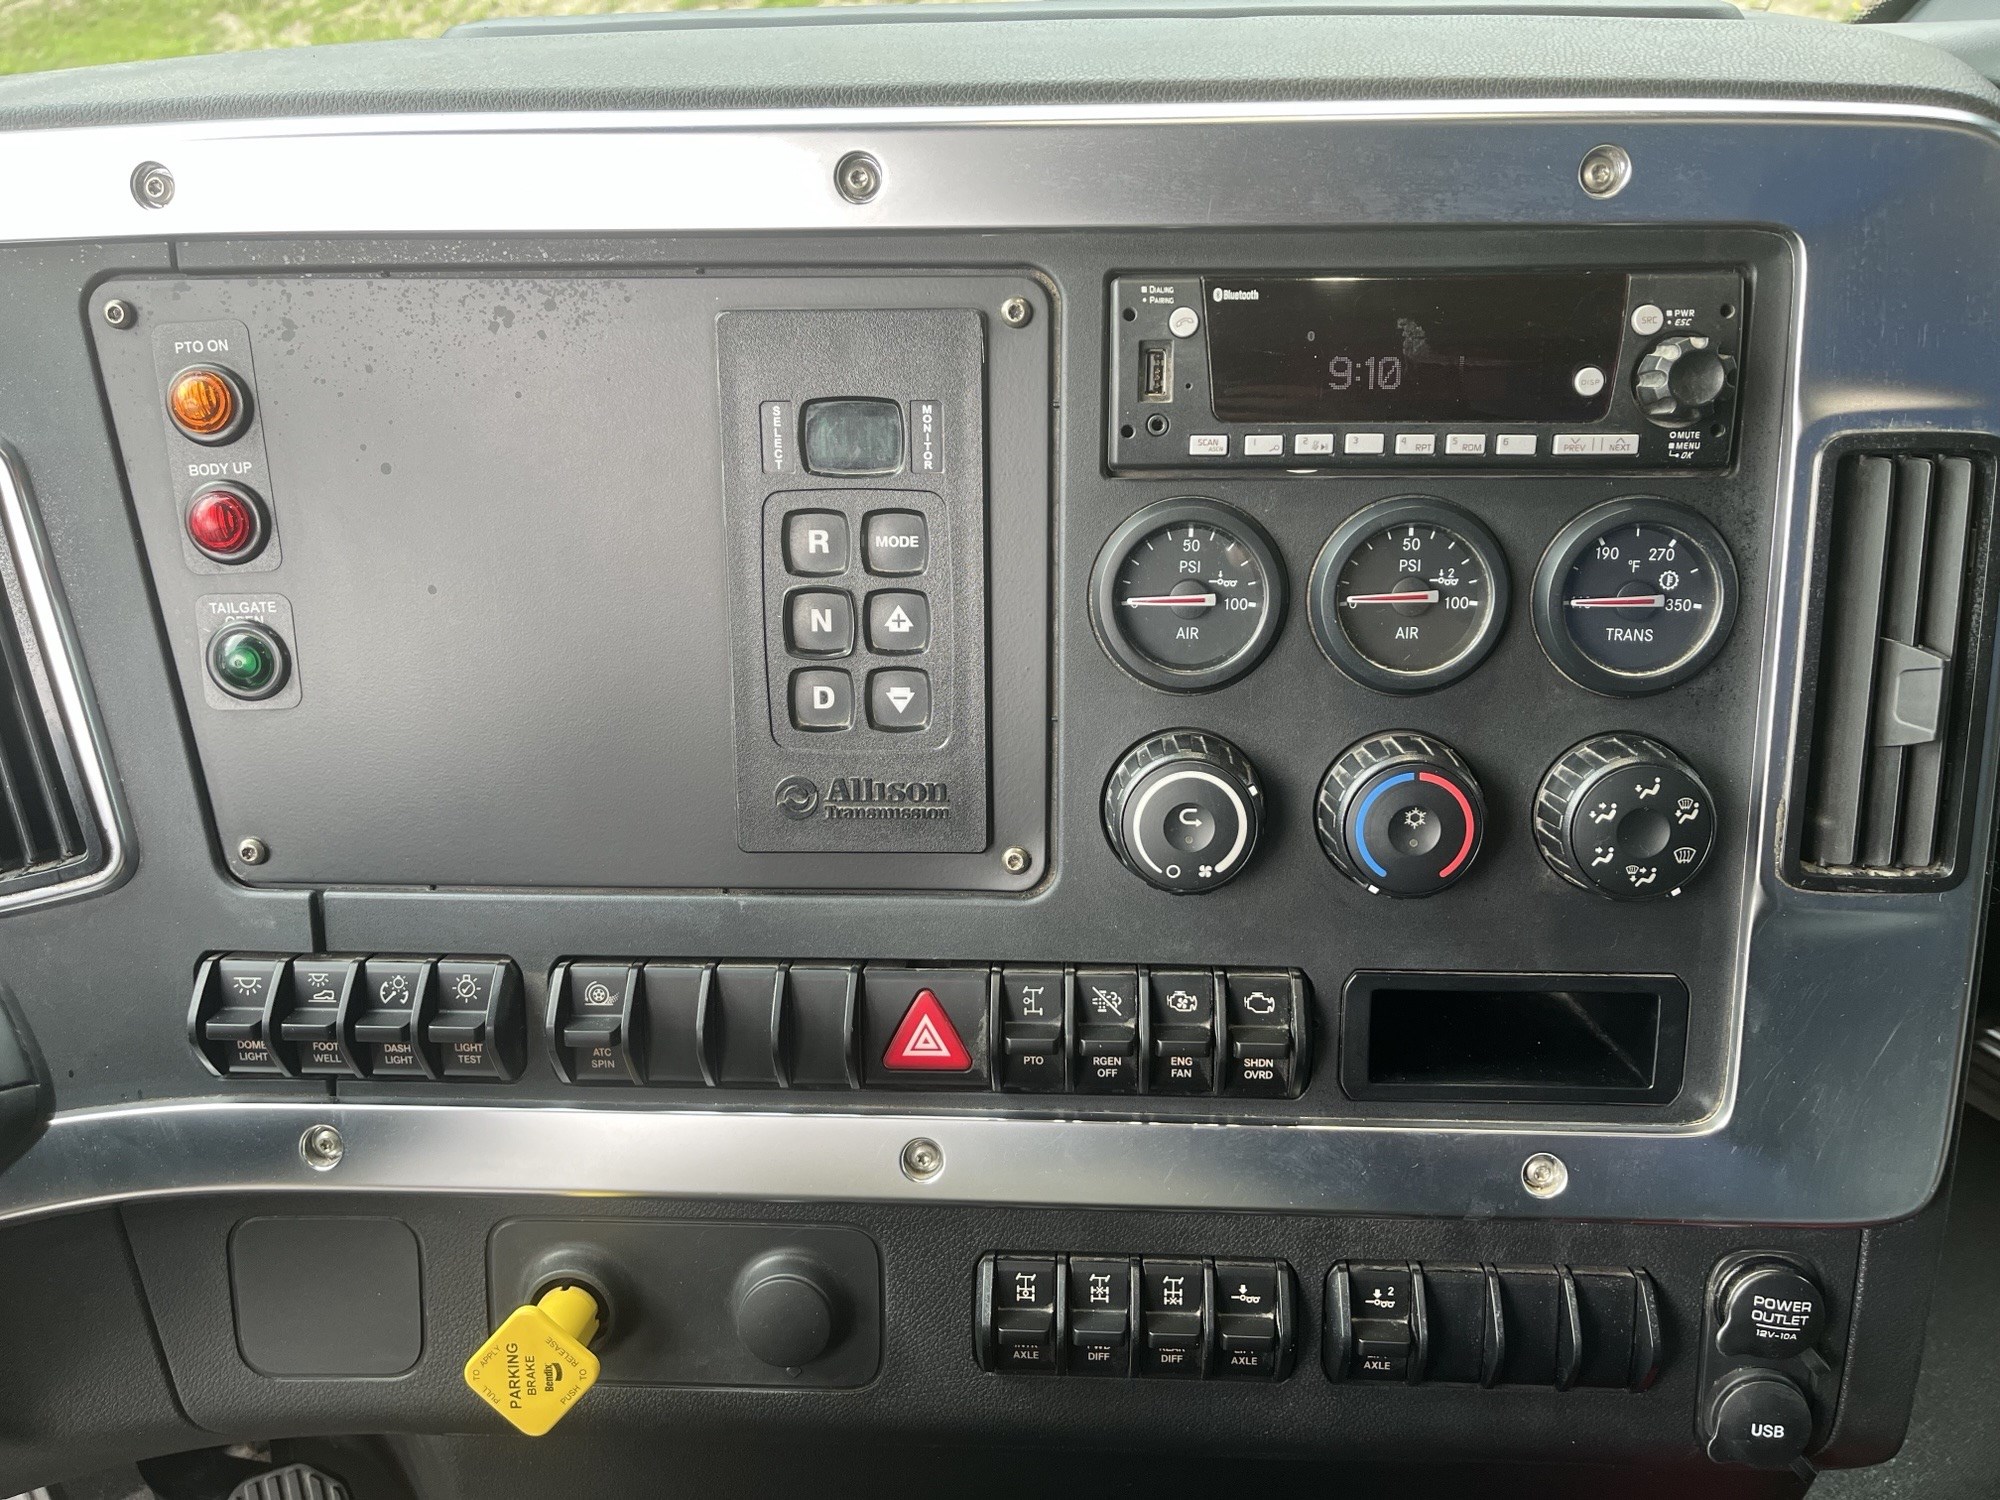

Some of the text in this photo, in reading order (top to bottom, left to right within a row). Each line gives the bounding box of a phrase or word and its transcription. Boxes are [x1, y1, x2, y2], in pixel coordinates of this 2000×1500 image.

[1149, 286, 1174, 294] DIALING
[1223, 289, 1259, 300] Bluetooth
[1149, 296, 1174, 304] PAIRING
[1674, 309, 1695, 317] PWR
[1641, 316, 1658, 324] SRC
[1674, 318, 1692, 326] ESC
[175, 339, 229, 353] PTO ON
[1328, 356, 1402, 390] 9:10
[772, 405, 783, 470] SELECT
[922, 405, 933, 470] MONITOR
[1353, 436, 1359, 444] 3
[1401, 436, 1407, 444] 4
[1677, 431, 1700, 439] MUTE
[1452, 437, 1458, 445] 5
[1503, 438, 1509, 446] 6
[1675, 442, 1700, 450] MENU
[1564, 444, 1586, 452] PREV
[1680, 451, 1694, 459] OK
[188, 462, 252, 476] BODY UP
[808, 530, 829, 554] R
[875, 535, 919, 548] MODE
[1183, 539, 1200, 552] 50
[1402, 538, 1421, 551] 50
[1595, 547, 1620, 560] 190
[1649, 548, 1675, 561] 270
[1179, 560, 1201, 573] PSI
[1399, 559, 1421, 572] PSI
[1448, 568, 1455, 578] 2
[208, 601, 277, 614] TAILGATE
[1224, 598, 1248, 610] 100
[1444, 597, 1469, 609] 100
[1665, 598, 1692, 611] 350
[812, 608, 832, 632] N
[1176, 627, 1199, 639] AIR
[1395, 627, 1419, 639] AIR
[1606, 628, 1654, 642] TRANS
[814, 686, 834, 709] D
[823, 777, 950, 802] Allison
[824, 804, 950, 819] Transmission
[237, 1040, 266, 1049] DOME
[313, 1042, 338, 1051] FOOT
[384, 1044, 411, 1053] DASH
[454, 1043, 483, 1052] LIGHT
[239, 1052, 268, 1061] LIGHT
[593, 1048, 612, 1057] ATC
[313, 1054, 341, 1063] WELL
[385, 1056, 413, 1065] LIGHT
[458, 1055, 482, 1064] TEST
[1023, 1056, 1044, 1065] PTO
[1093, 1057, 1122, 1067] RGEN
[1171, 1057, 1193, 1067] ENG
[1244, 1058, 1274, 1068] SHDN
[591, 1060, 615, 1068] SPIN
[1097, 1068, 1117, 1078] OFF
[1171, 1068, 1192, 1078] FAN
[1244, 1070, 1273, 1080] OVRD
[1388, 1287, 1394, 1296] 2
[1753, 1295, 1812, 1313] POWER
[1751, 1310, 1809, 1326] OUTLET
[1756, 1329, 1797, 1340] 12V-10A
[1013, 1351, 1039, 1359] AXLE
[1088, 1352, 1110, 1360] DIFF
[1161, 1354, 1183, 1363] DIFF
[1231, 1357, 1258, 1365] AXLE
[1363, 1361, 1390, 1370] AXLE
[472, 1345, 501, 1404] PULL TO APPLY
[506, 1342, 522, 1409] PARKING
[525, 1356, 537, 1395] BRAKE
[545, 1336, 587, 1405] PUSH TO RELEASE
[544, 1364, 554, 1392] Bendix
[1751, 1423, 1785, 1438] USB
